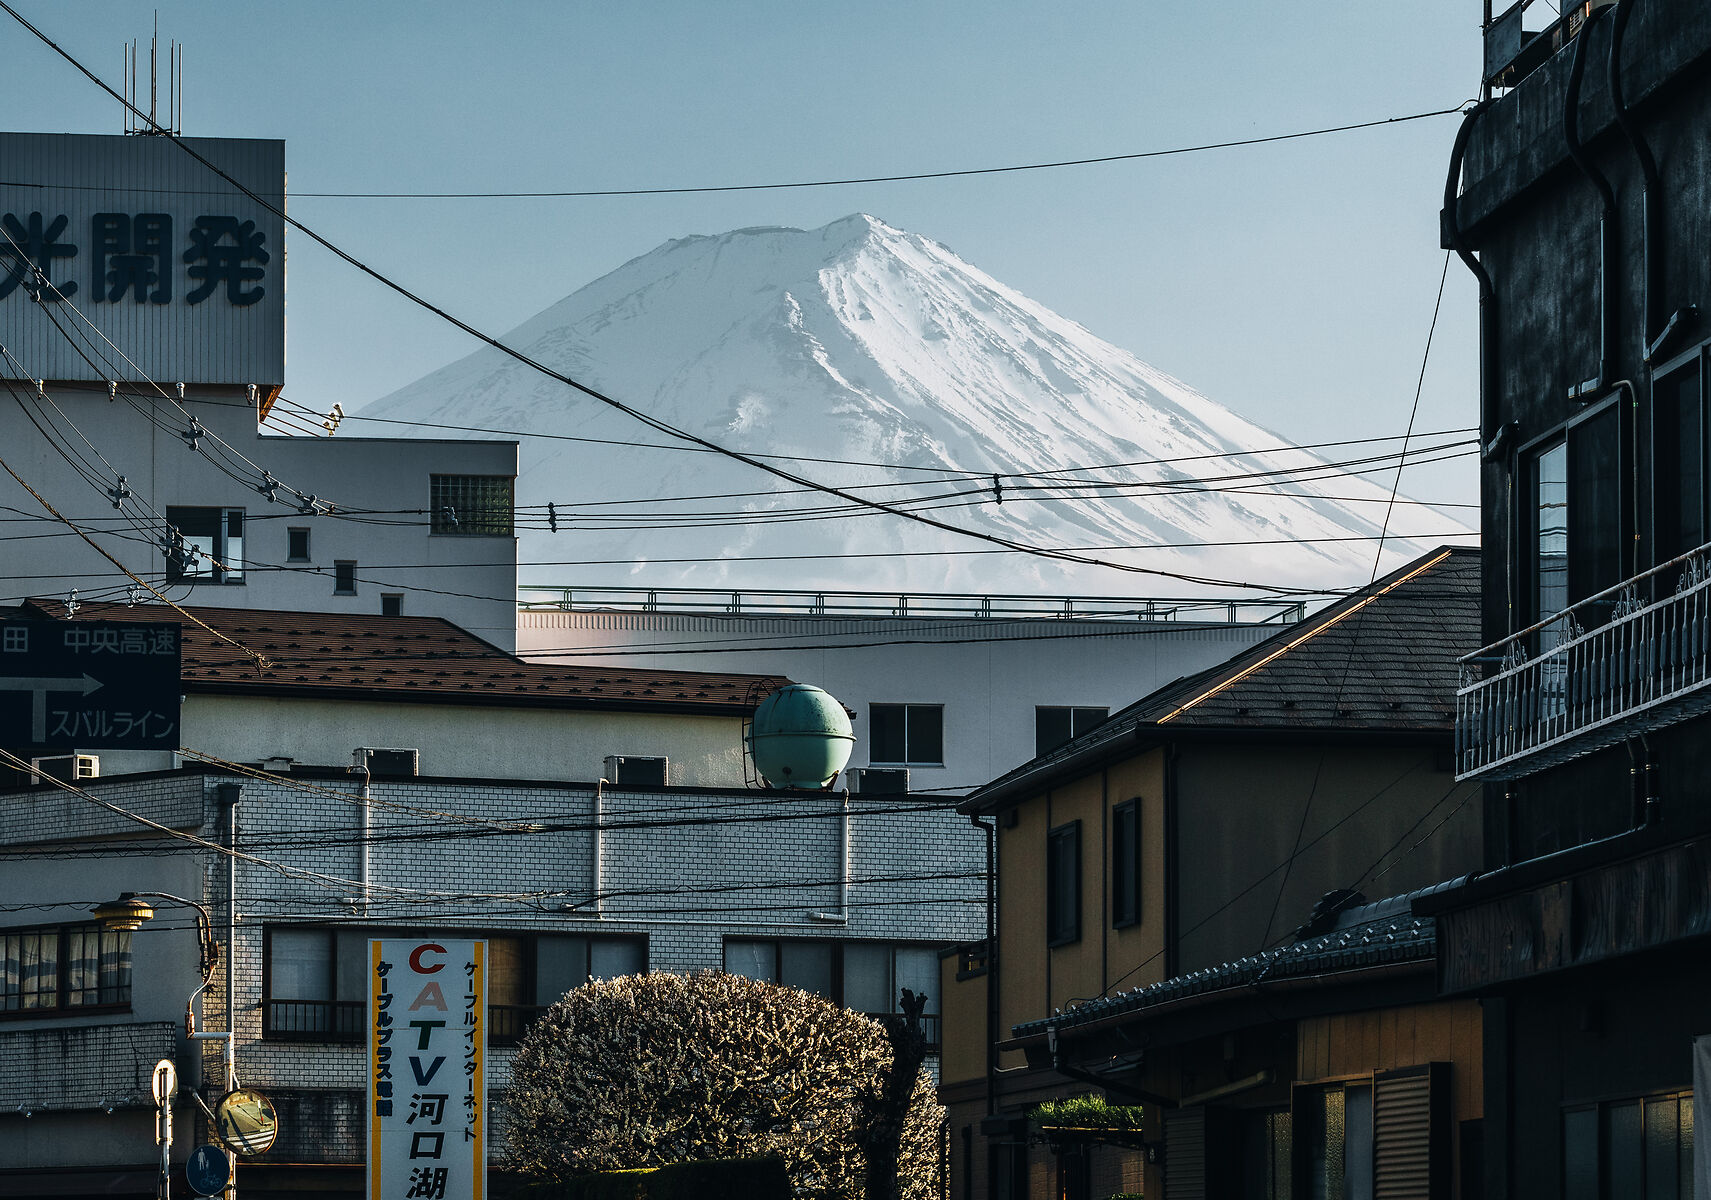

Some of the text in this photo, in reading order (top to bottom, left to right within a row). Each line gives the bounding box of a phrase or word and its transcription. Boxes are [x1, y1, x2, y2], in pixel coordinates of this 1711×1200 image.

[4, 627, 28, 652] 田
[64, 626, 175, 655] 中央高速
[51, 710, 174, 738] スバルライン
[463, 961, 478, 1142] ケーブルインターネット
